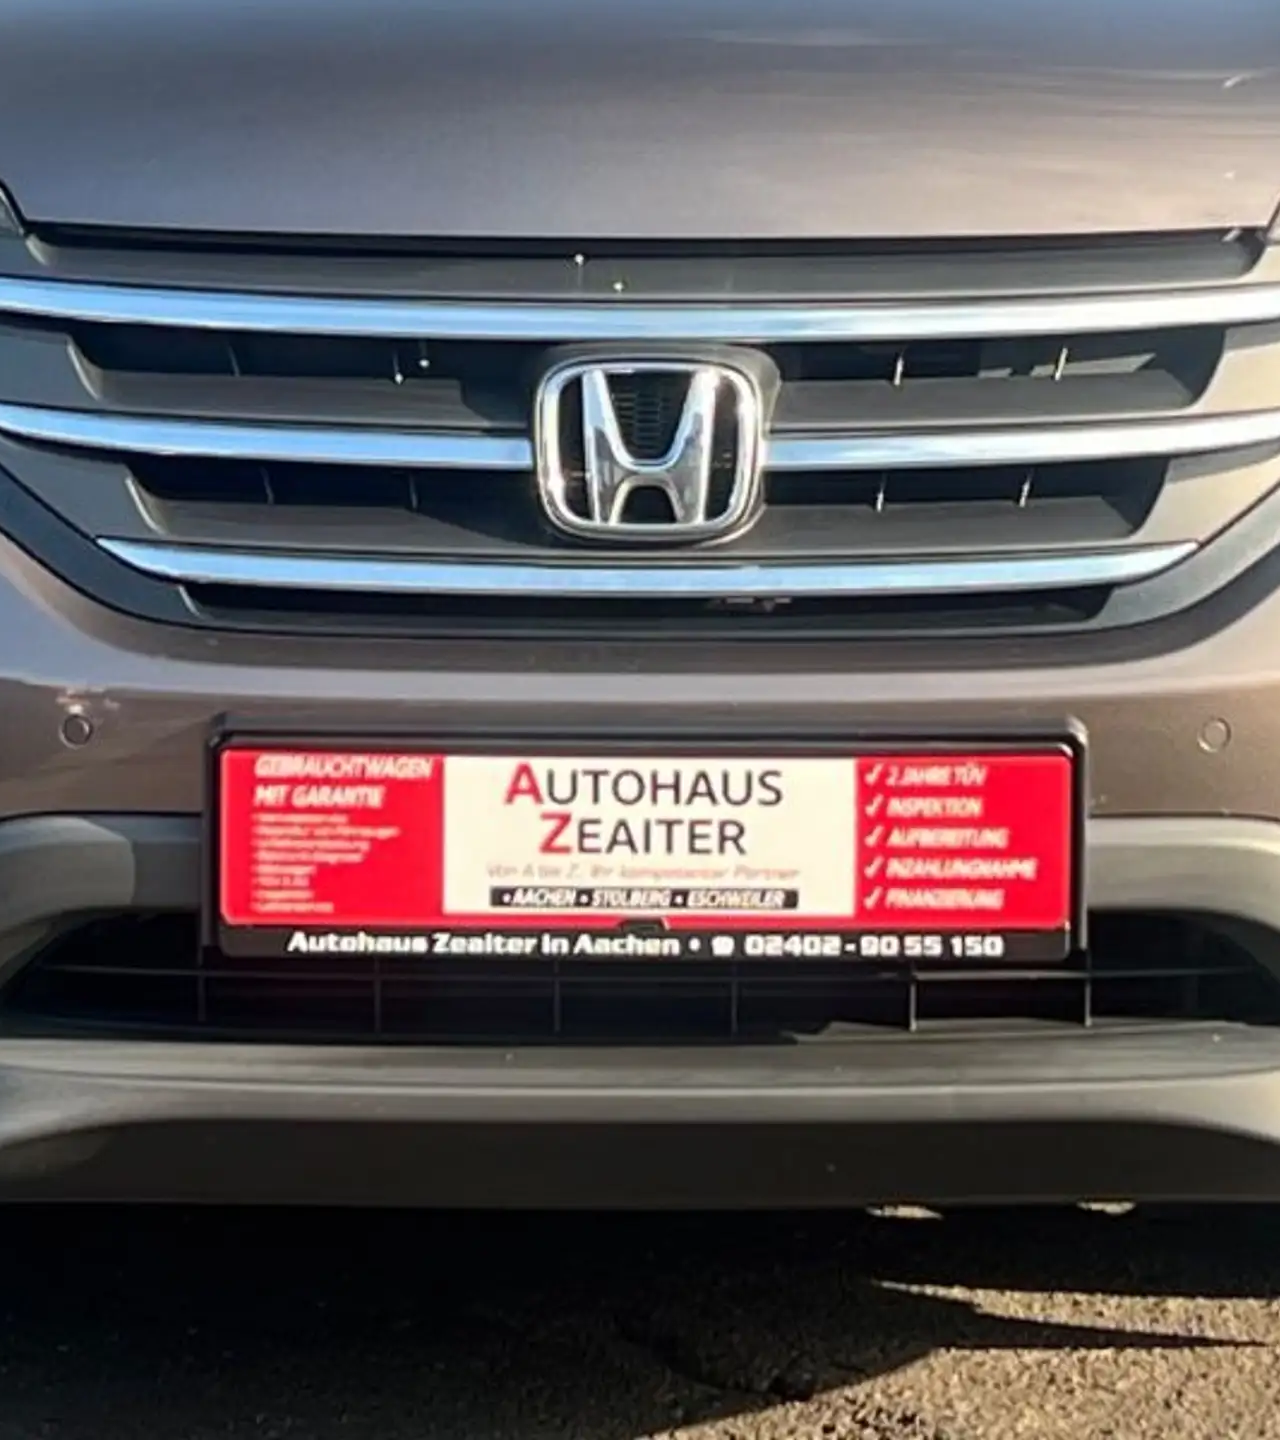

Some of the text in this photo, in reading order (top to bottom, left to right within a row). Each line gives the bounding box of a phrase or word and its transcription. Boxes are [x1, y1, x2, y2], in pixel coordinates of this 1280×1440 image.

[254, 753, 433, 779] GEBRAUCHTWAGEN
[253, 783, 387, 809] MIT GARANTIE
[504, 761, 783, 807] AUTOHAUS
[886, 797, 984, 818] INSPEKTION
[539, 812, 747, 855] ZEAITER
[886, 827, 1010, 848] AUFBEREITUNG
[510, 887, 786, 908] AACHEN STOLBERG ESCHWEILER
[287, 931, 429, 953] Autohaus
[433, 932, 538, 954] Zeaiter
[573, 933, 681, 955] Aachen
[951, 936, 1005, 957] 150
